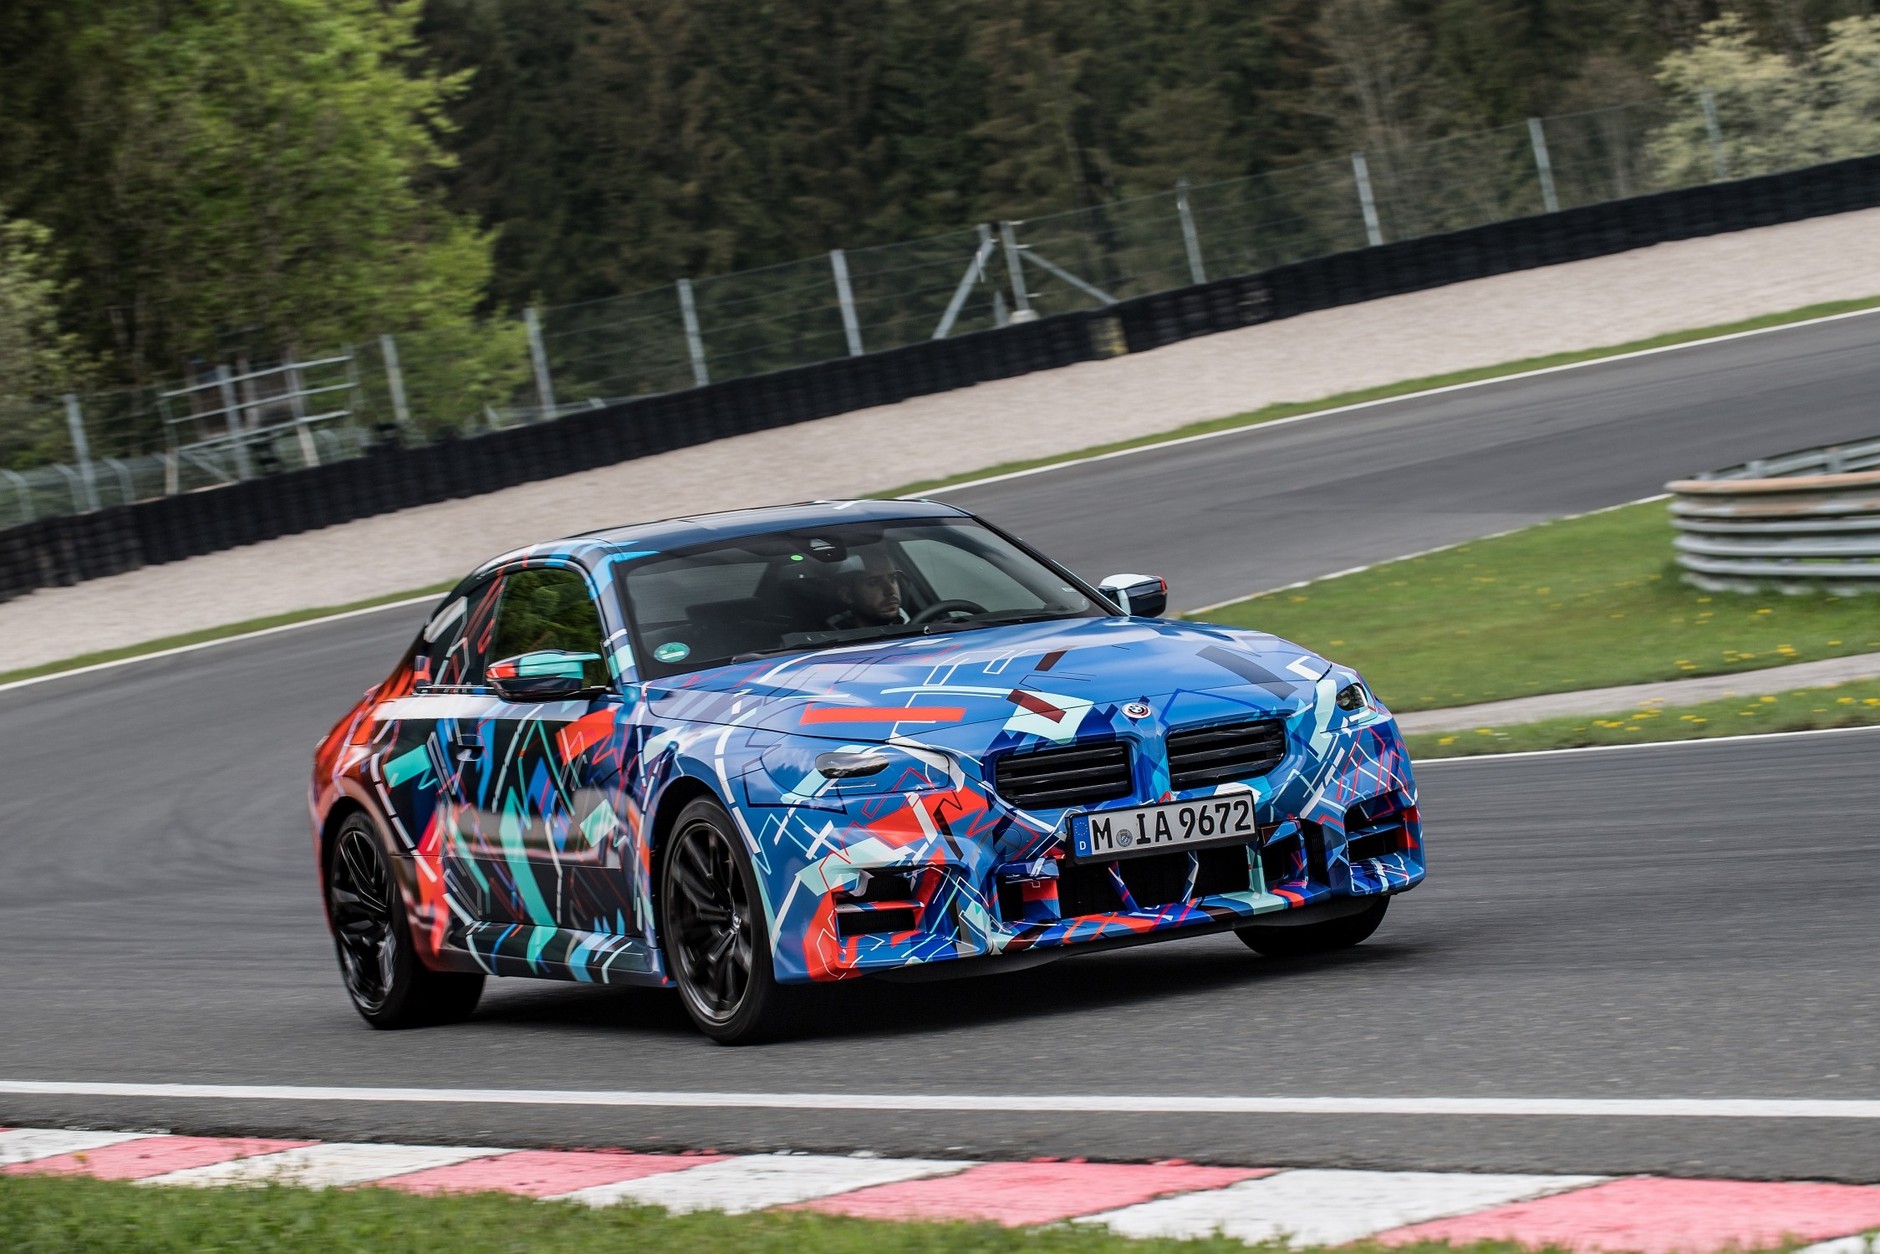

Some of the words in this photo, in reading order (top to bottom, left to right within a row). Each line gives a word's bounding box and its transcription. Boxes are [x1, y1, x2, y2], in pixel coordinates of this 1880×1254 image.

[1092, 817, 1113, 850] M
[1136, 810, 1172, 845] IA
[1179, 800, 1251, 838] 9672
[1080, 840, 1087, 850] D
